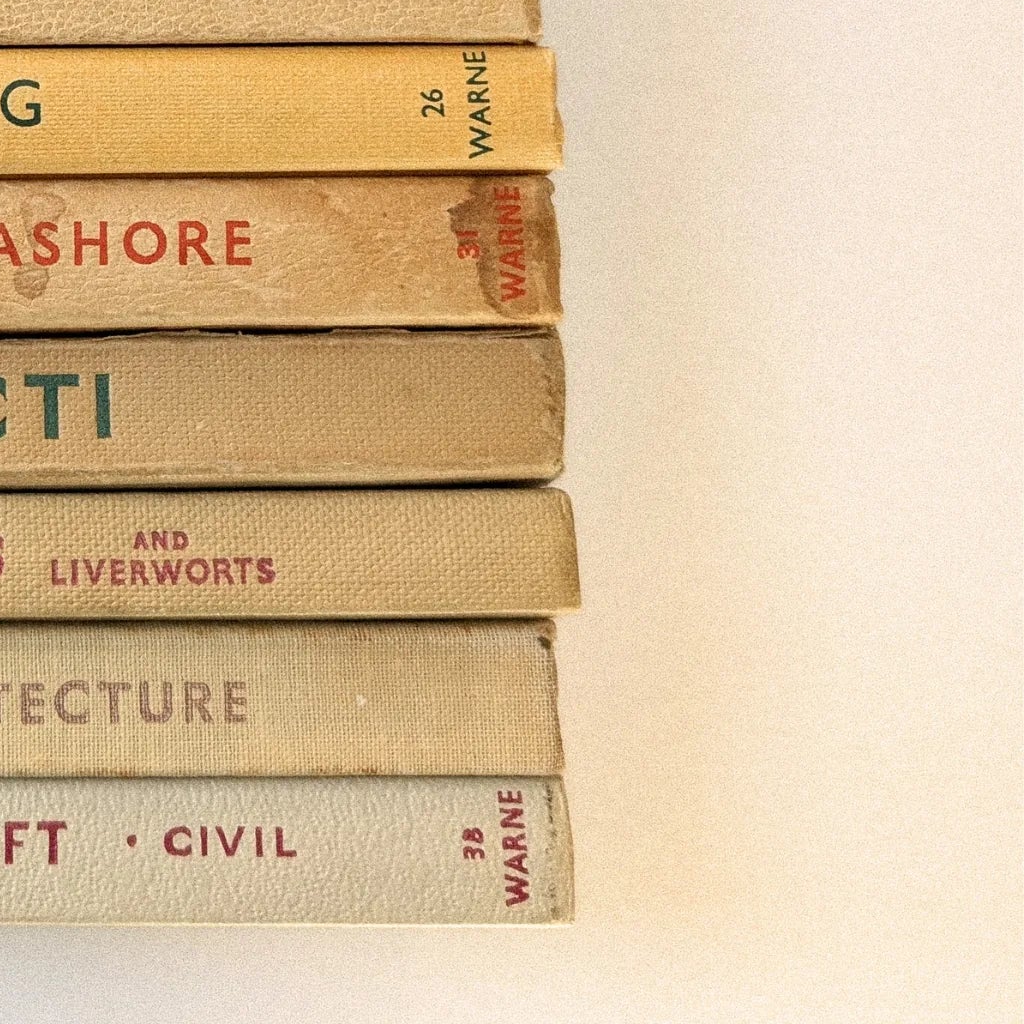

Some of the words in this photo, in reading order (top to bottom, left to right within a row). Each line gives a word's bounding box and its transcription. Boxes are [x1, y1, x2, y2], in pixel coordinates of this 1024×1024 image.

[421, 88, 445, 118] 26
[462, 50, 494, 159] WARNE
[457, 229, 479, 259] 31
[494, 184, 525, 302] WARNE
[133, 530, 190, 551] AND
[51, 557, 277, 587] LIVERWORTS
[163, 825, 297, 858] CIVIL
[498, 789, 530, 907] WARNE
